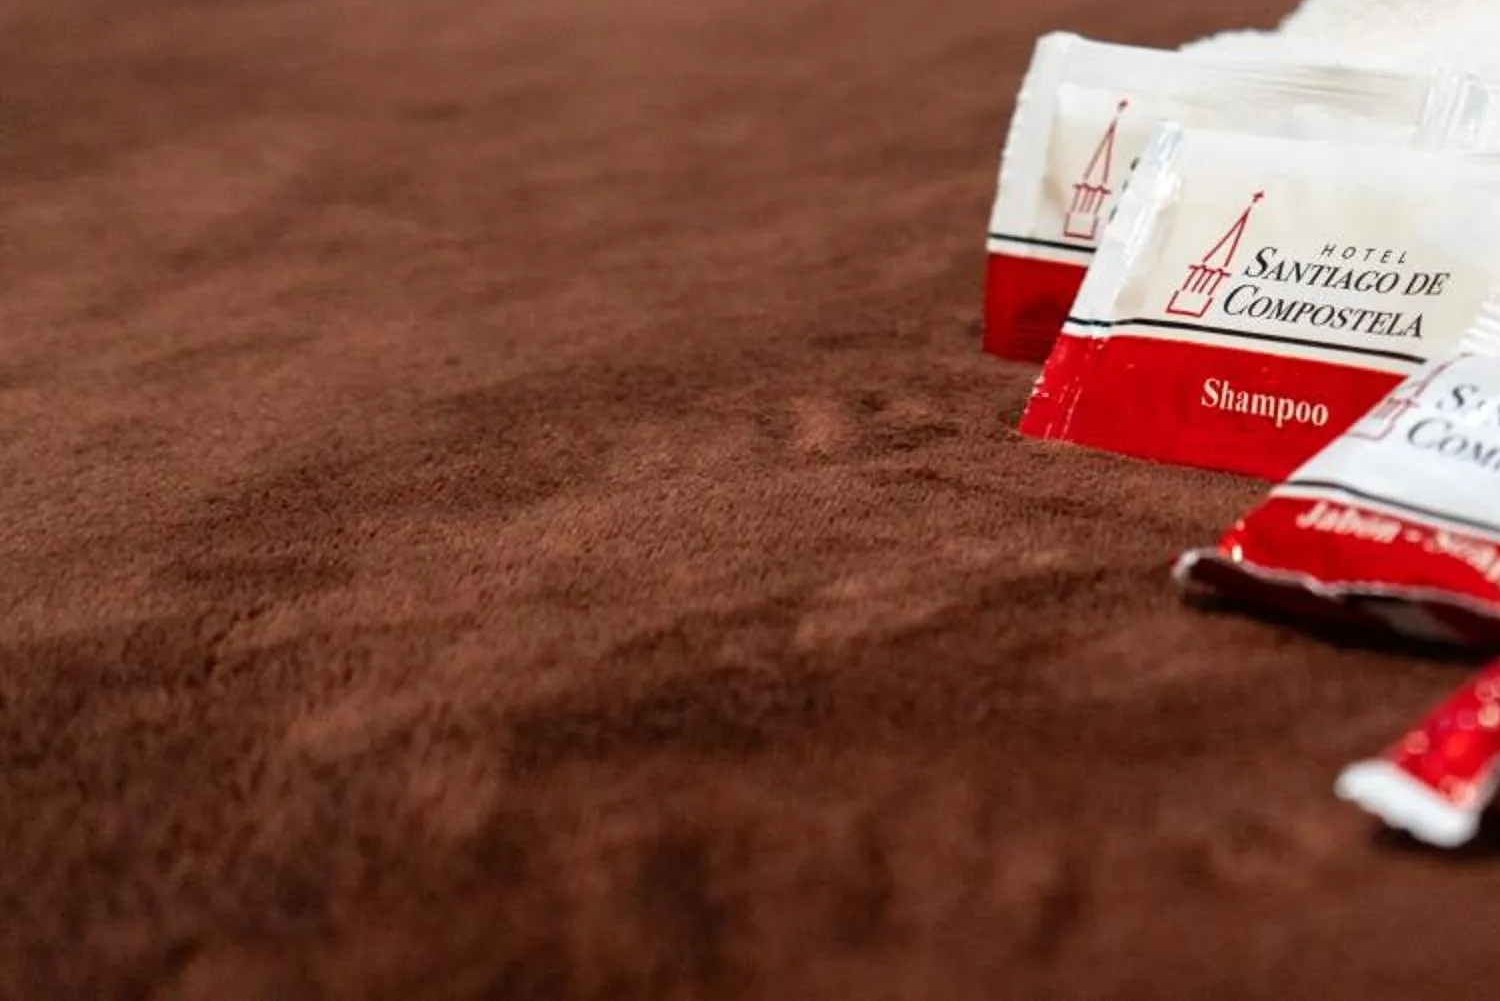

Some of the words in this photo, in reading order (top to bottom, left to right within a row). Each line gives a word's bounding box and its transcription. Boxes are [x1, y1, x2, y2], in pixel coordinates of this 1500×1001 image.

[1243, 245, 1400, 295] SANTIAGO
[1402, 271, 1451, 297] DE
[1320, 243, 1408, 264] HOTEL
[1222, 284, 1424, 339] COMPOSTELA
[1201, 377, 1329, 428] Shampoo
